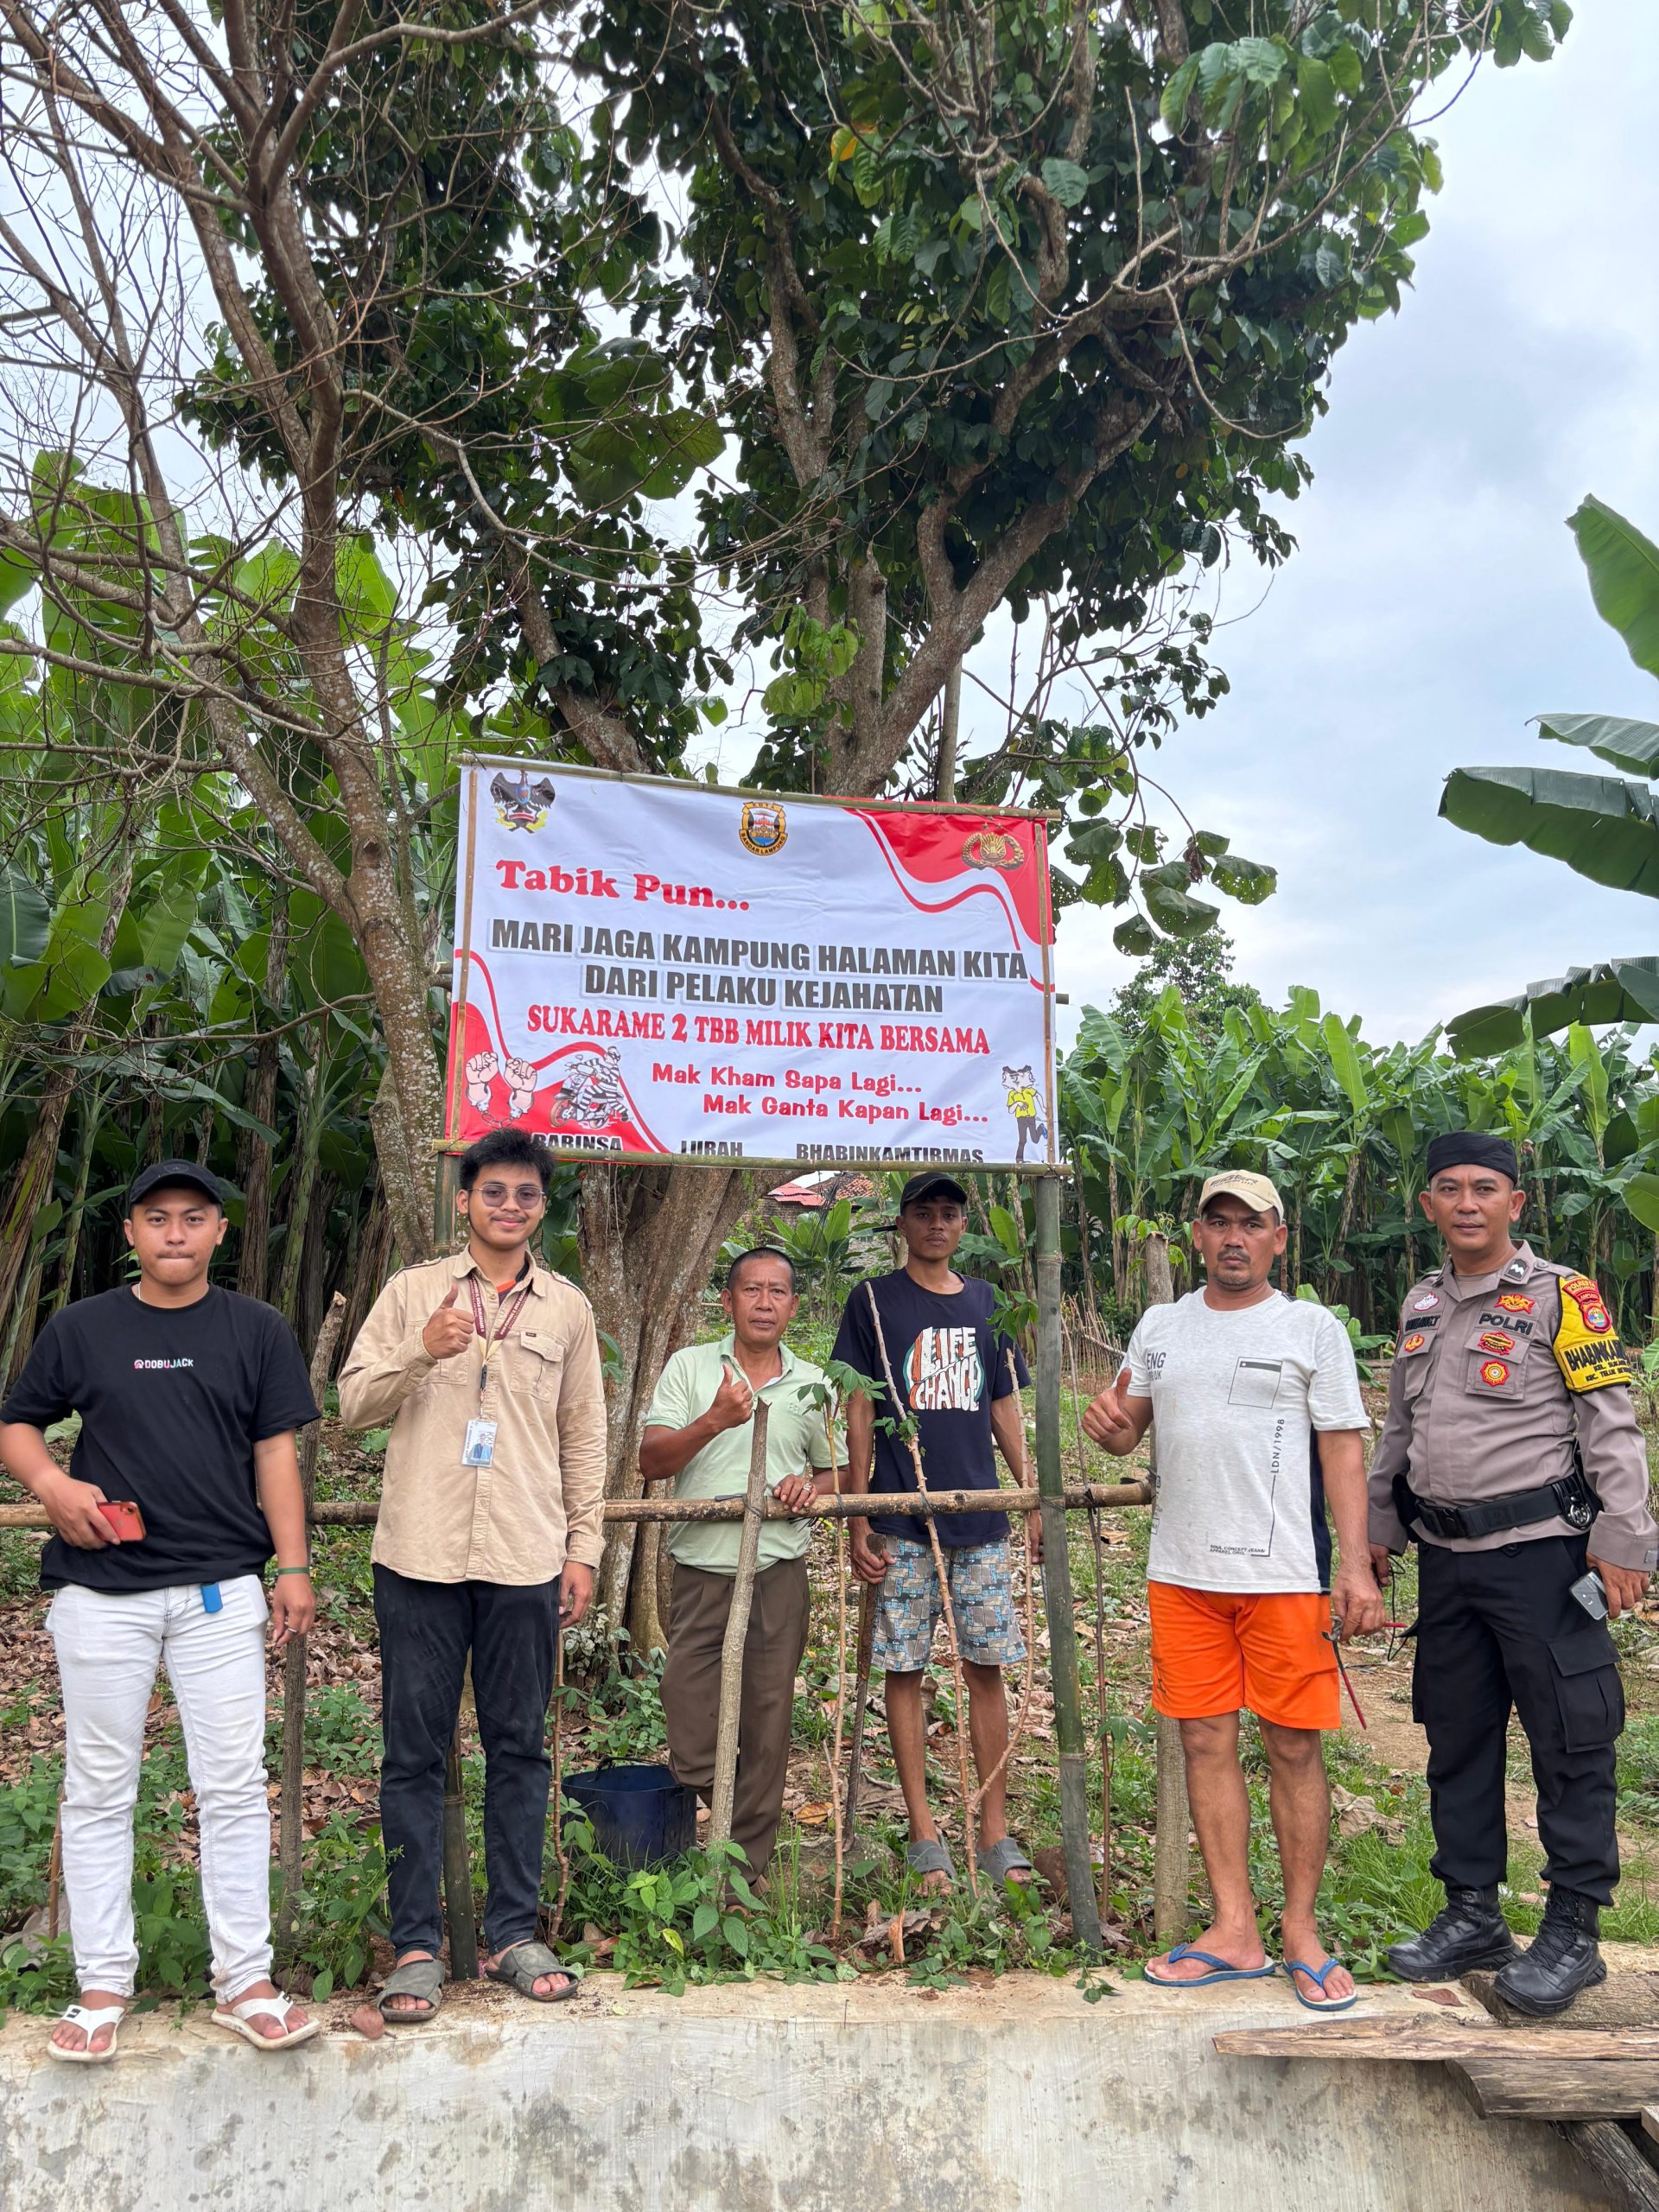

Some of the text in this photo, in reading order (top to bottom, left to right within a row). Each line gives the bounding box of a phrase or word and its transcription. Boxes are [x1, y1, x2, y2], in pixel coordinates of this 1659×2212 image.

[496, 860, 750, 911] Tabik Pun...
[492, 918, 1028, 979] MARI JAGA KAMPUNG HALAMAN KITA
[585, 964, 943, 1013] DARI PELAKU KEJAHATAN
[527, 1004, 990, 1054] SUKARAME 2 TBB MILIK KITA BERSAMA
[652, 1063, 922, 1097] Mak Kham Sapa Lagi...
[703, 1094, 988, 1126] Mak Ganta Kapan Lagi...
[1478, 1313, 1534, 1336] POLRI
[144, 1358, 194, 1370] DOBUJACK
[921, 1326, 976, 1377] LIFE
[1270, 1419, 1285, 1473] LDN/1998
